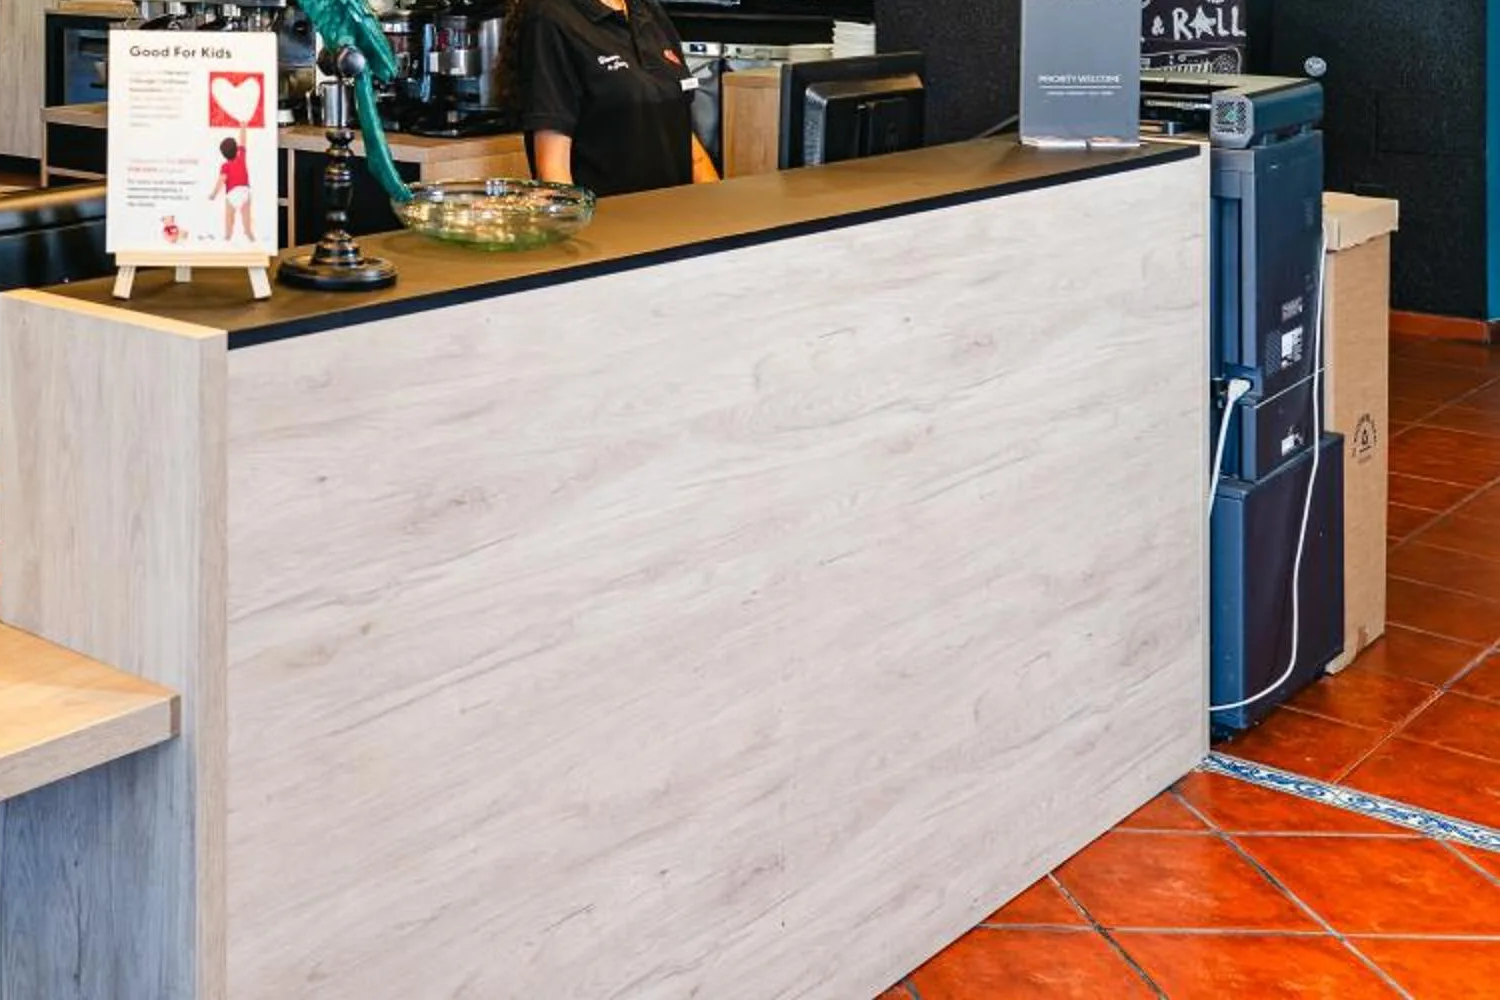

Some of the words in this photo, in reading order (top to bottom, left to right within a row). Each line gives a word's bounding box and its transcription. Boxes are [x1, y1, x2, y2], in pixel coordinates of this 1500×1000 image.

[129, 45, 169, 58] Good
[174, 46, 197, 59] For
[201, 47, 232, 60] Kids
